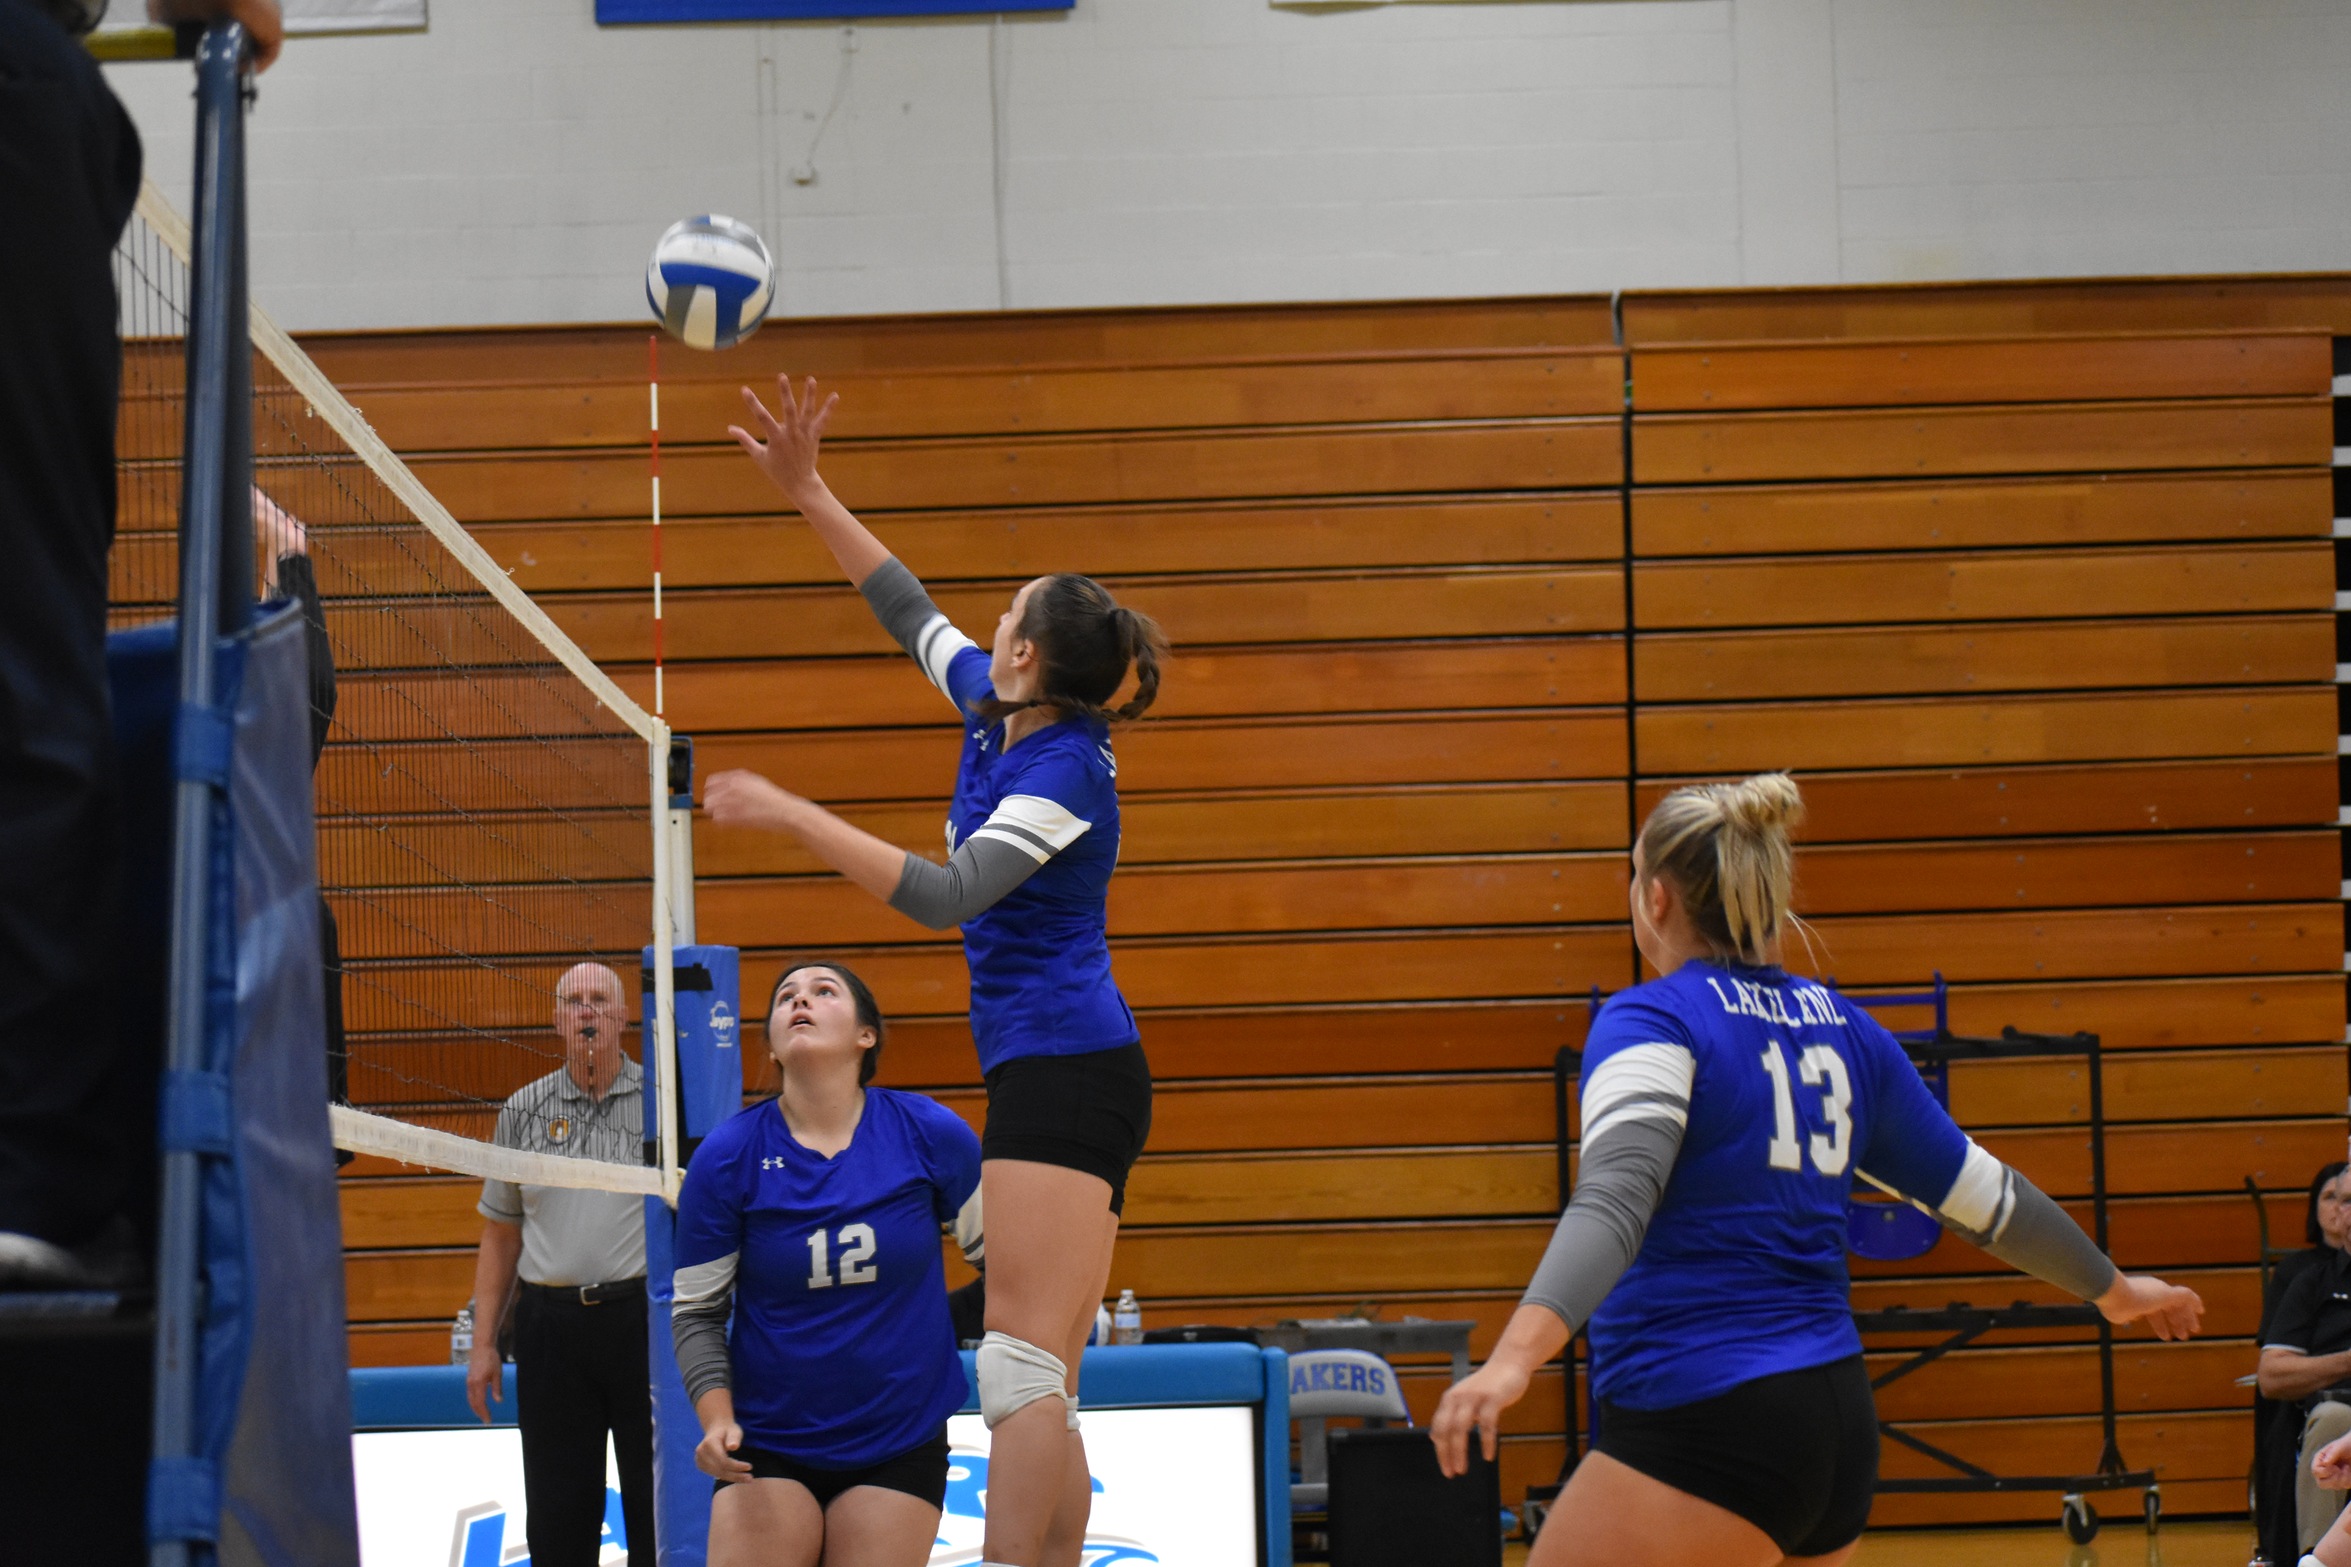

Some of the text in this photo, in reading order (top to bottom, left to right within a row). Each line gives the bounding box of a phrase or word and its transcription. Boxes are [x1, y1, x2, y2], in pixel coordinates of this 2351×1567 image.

[1760, 1039, 1853, 1177] 13
[806, 1222, 878, 1289] 12
[1291, 1363, 1386, 1396] AKERS
